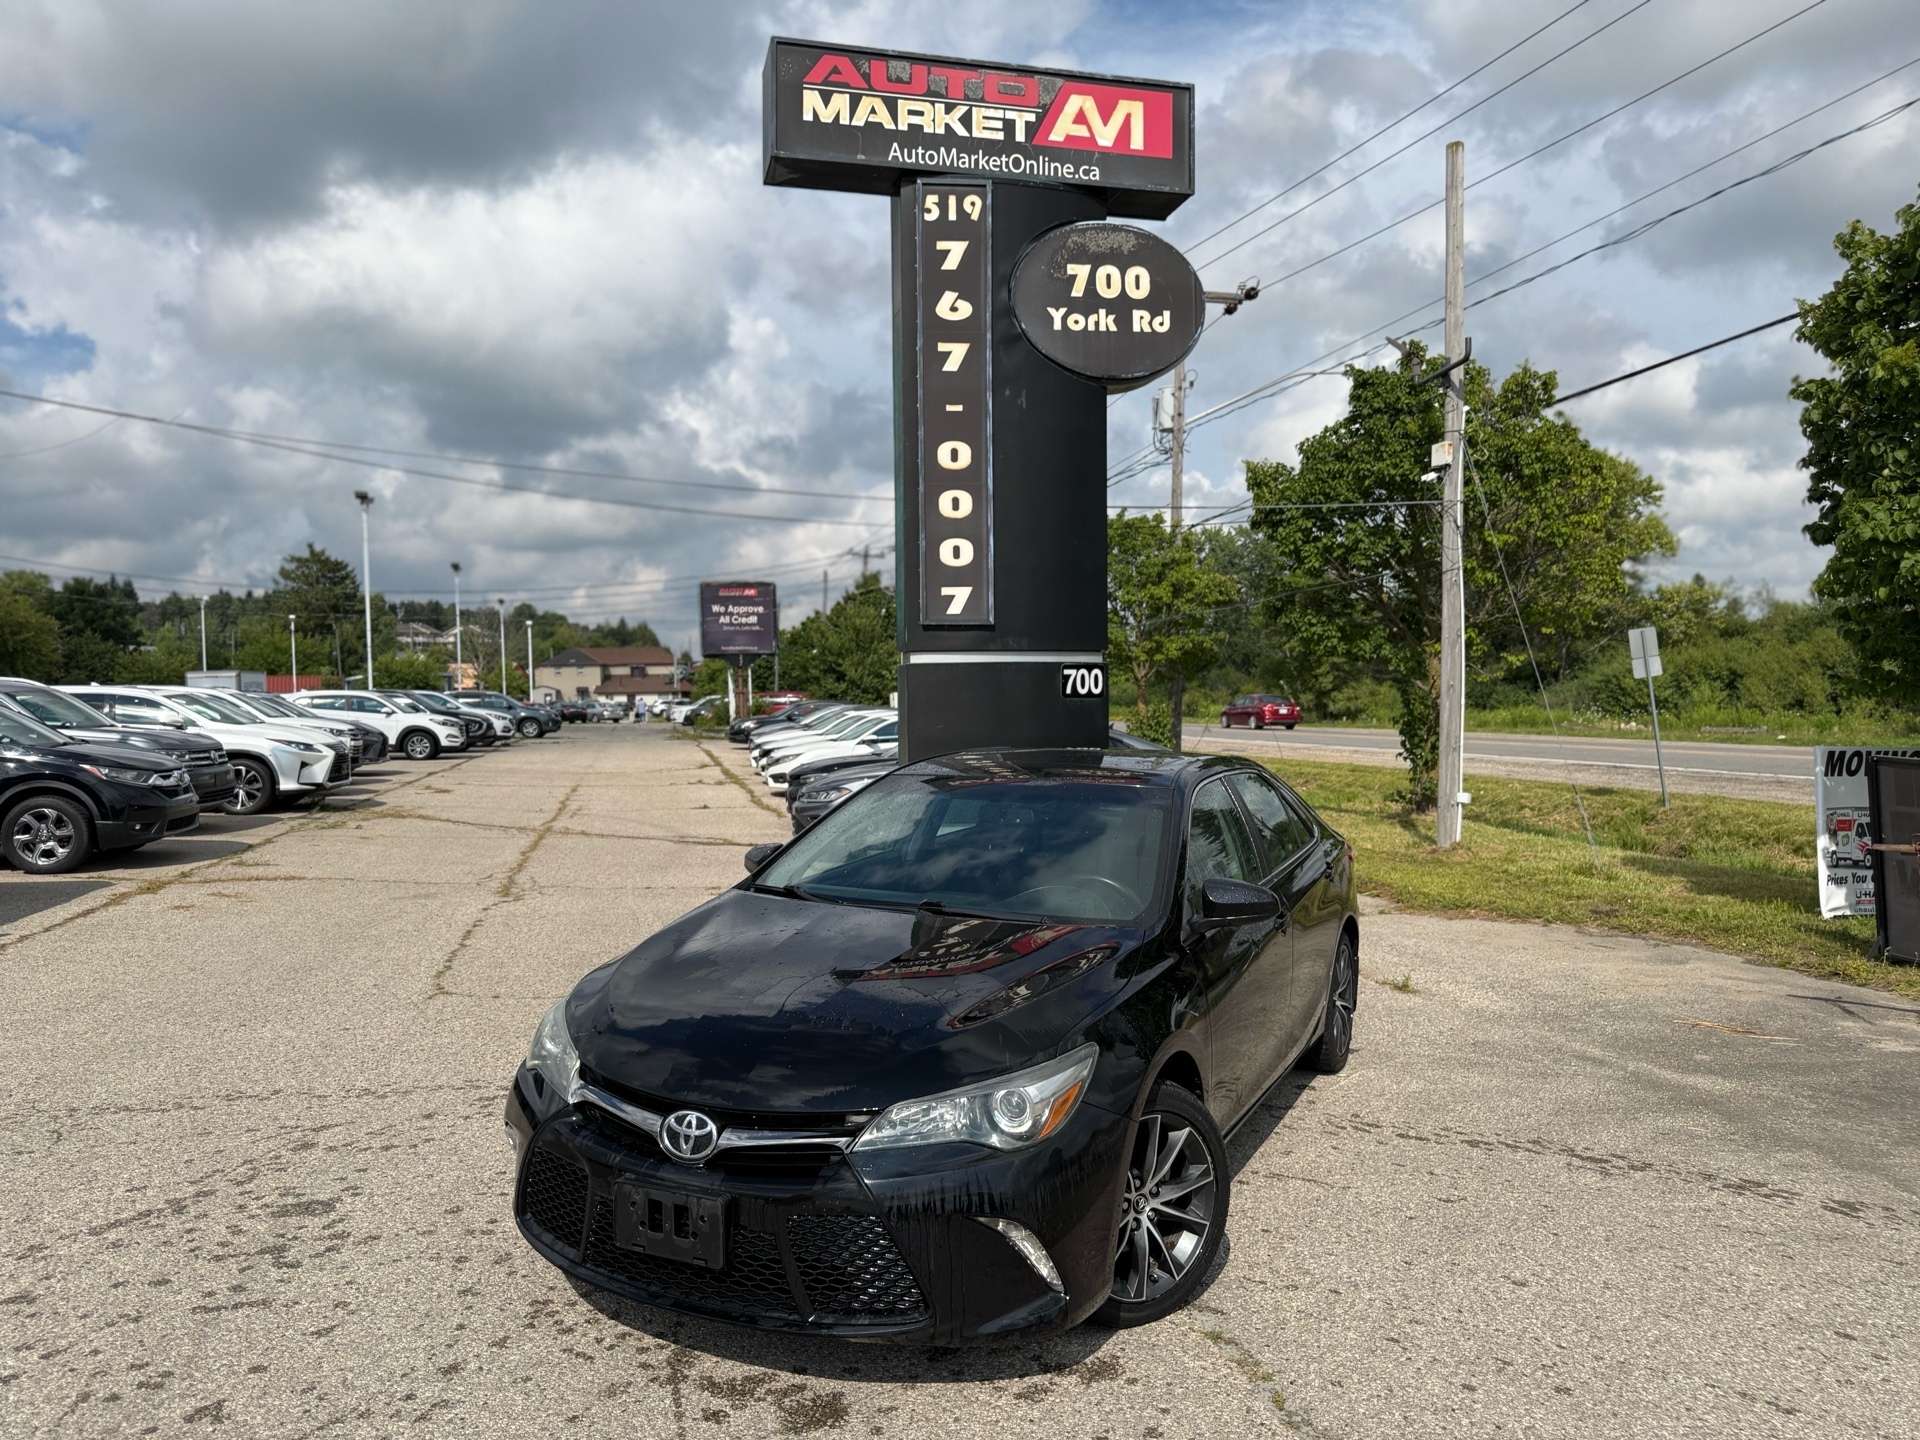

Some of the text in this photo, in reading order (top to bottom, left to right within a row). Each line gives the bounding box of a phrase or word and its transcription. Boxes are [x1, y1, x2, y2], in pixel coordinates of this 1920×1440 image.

[802, 54, 1040, 107] AUTO
[802, 90, 1036, 143] MARKET
[888, 142, 1101, 182] AutoMarketOnline.ca
[923, 194, 983, 222] 519
[1066, 263, 1152, 300] 700
[1046, 306, 1172, 334] York Rd
[712, 605, 764, 615] We Approve
[719, 616, 758, 624] All Credit
[1062, 668, 1104, 695] 700
[1826, 873, 1849, 886] Prices
[1851, 872, 1868, 884] You
